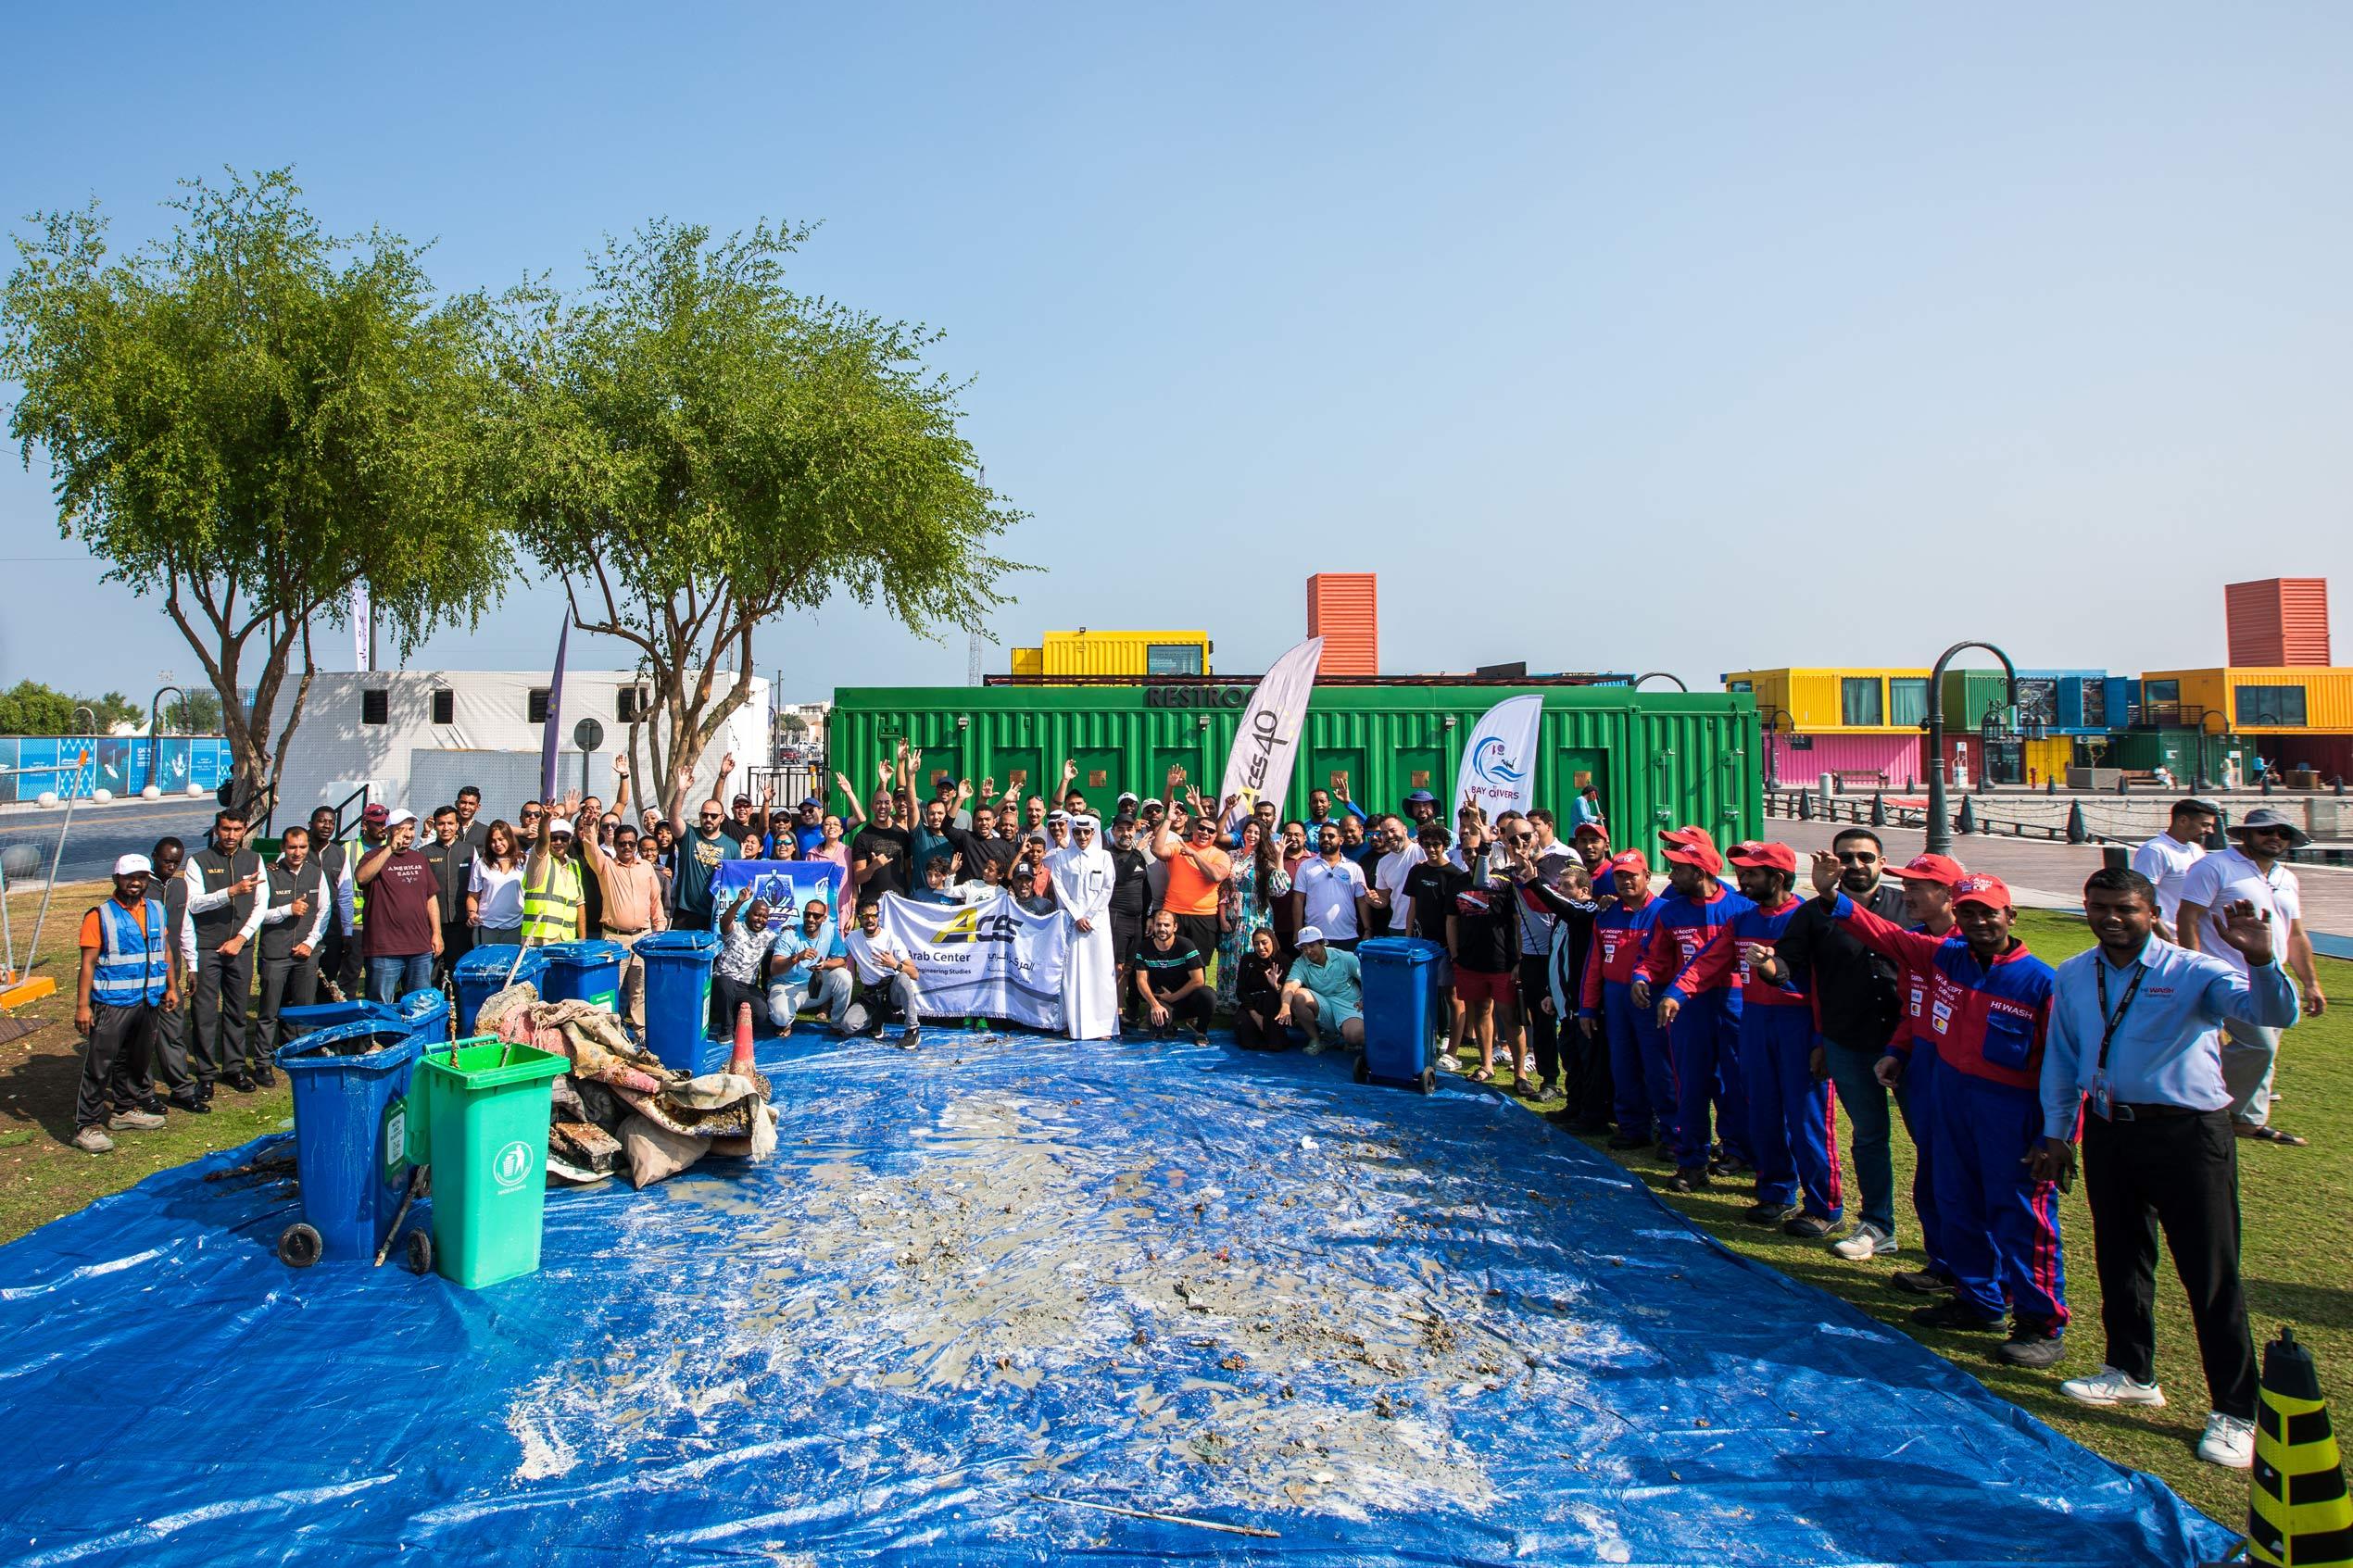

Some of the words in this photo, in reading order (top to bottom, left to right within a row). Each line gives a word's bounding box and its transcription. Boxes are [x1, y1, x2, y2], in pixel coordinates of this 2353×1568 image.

[1471, 786, 1487, 795] BAY
[931, 907, 1024, 944] ACES
[908, 950, 930, 961] Arab
[933, 952, 971, 961] Center
[1936, 1005, 1948, 1016] VISA
[1990, 1000, 2002, 1010] Hi
[2002, 1005, 2033, 1020] WASH
